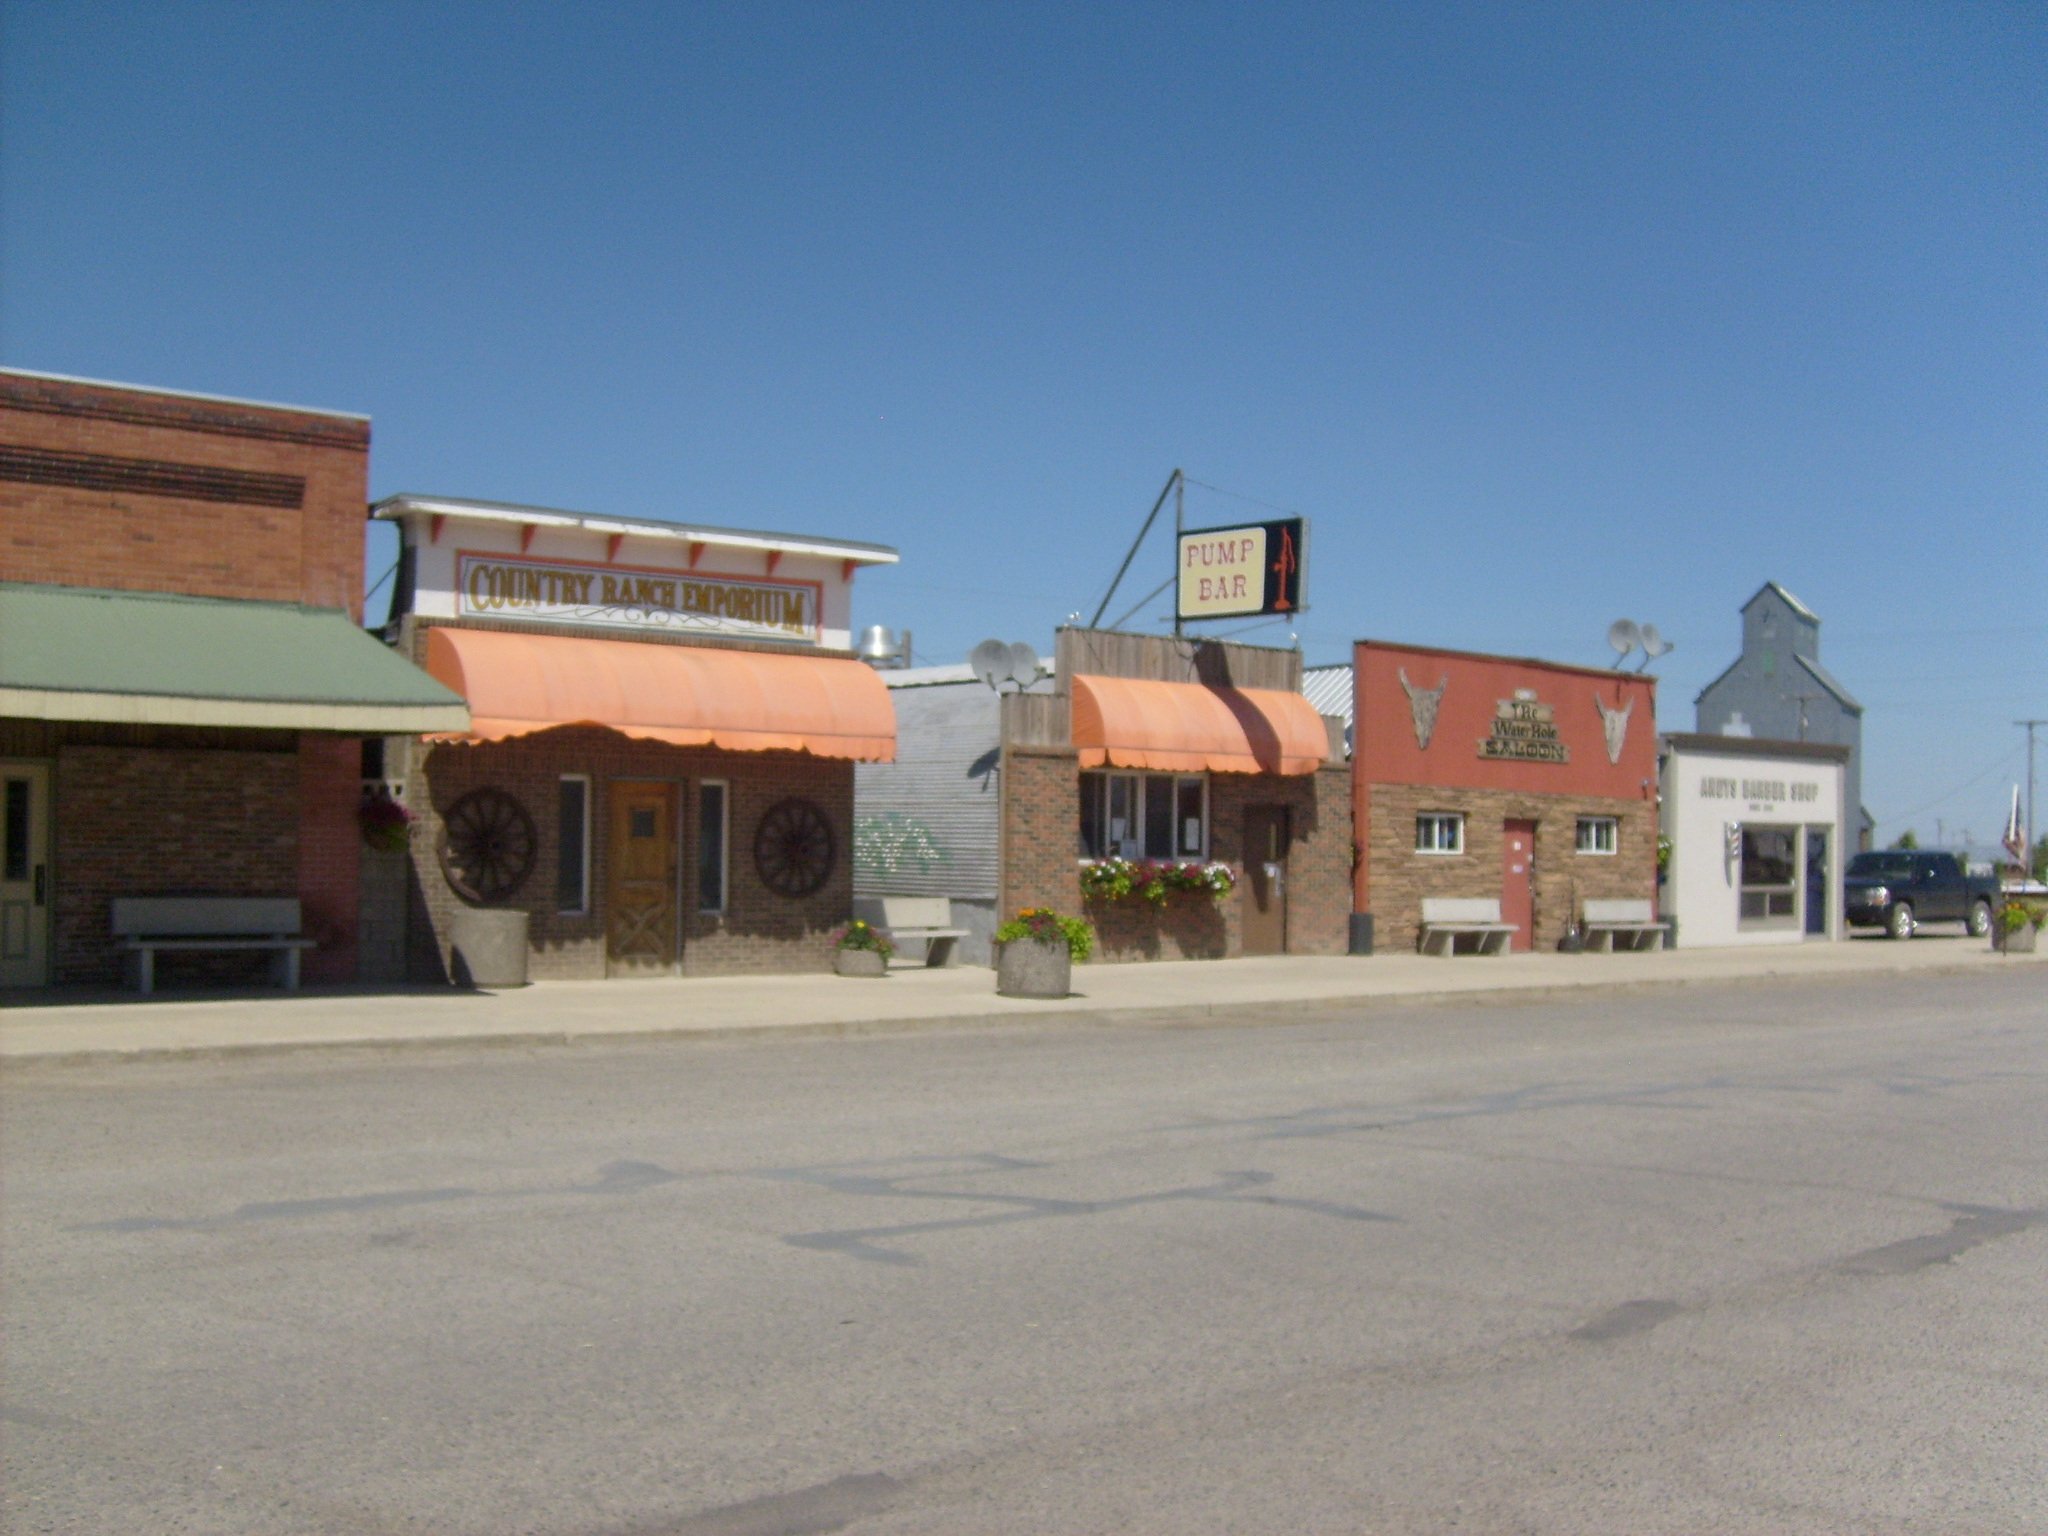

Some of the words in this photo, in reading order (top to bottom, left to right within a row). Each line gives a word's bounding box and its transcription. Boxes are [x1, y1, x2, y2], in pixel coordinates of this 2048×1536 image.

[1187, 539, 1254, 567] PUMP
[470, 564, 594, 611] COUNTRY
[601, 575, 676, 608] RANCH
[682, 582, 804, 634] EMPORIUM
[1199, 574, 1246, 601] BAR
[1486, 740, 1564, 760] SALOON
[1742, 779, 1786, 801] BARBER
[1790, 782, 1819, 802] SHOP
